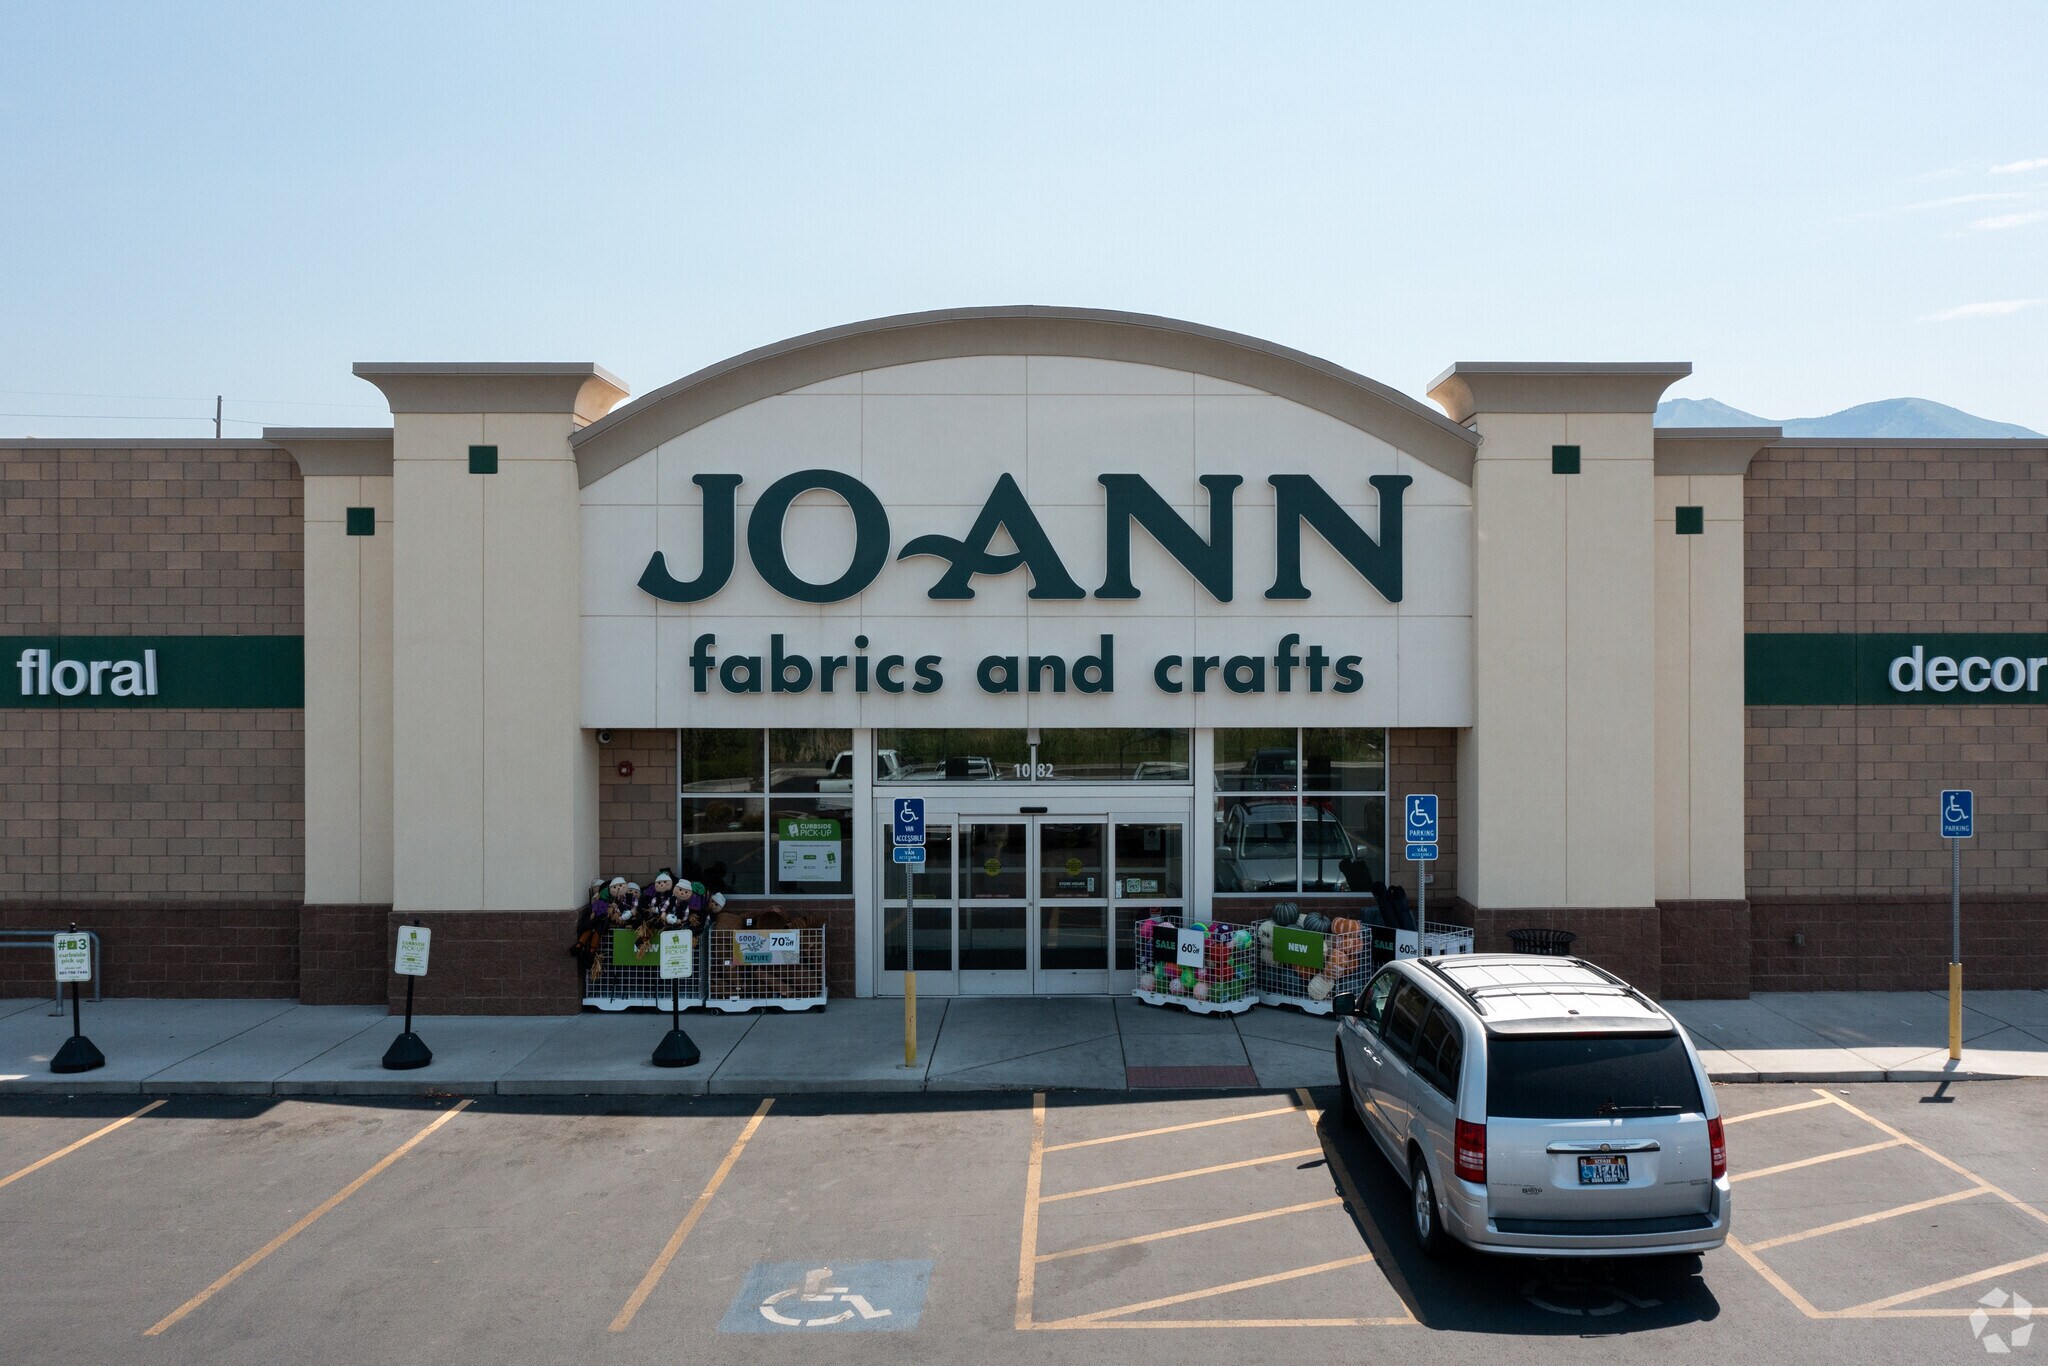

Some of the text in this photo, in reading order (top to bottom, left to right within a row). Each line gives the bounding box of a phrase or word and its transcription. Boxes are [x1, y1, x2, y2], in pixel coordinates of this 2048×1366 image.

[689, 633, 1364, 694] fabrics and crafts
[1888, 645, 2048, 692] decor
[16, 649, 158, 697] floral
[800, 829, 832, 837] PICK-UP
[896, 834, 923, 842] ACCESSIBLE
[1155, 939, 1176, 950] SALE
[1288, 942, 1308, 953] NEW
[1374, 940, 1394, 951] SALE
